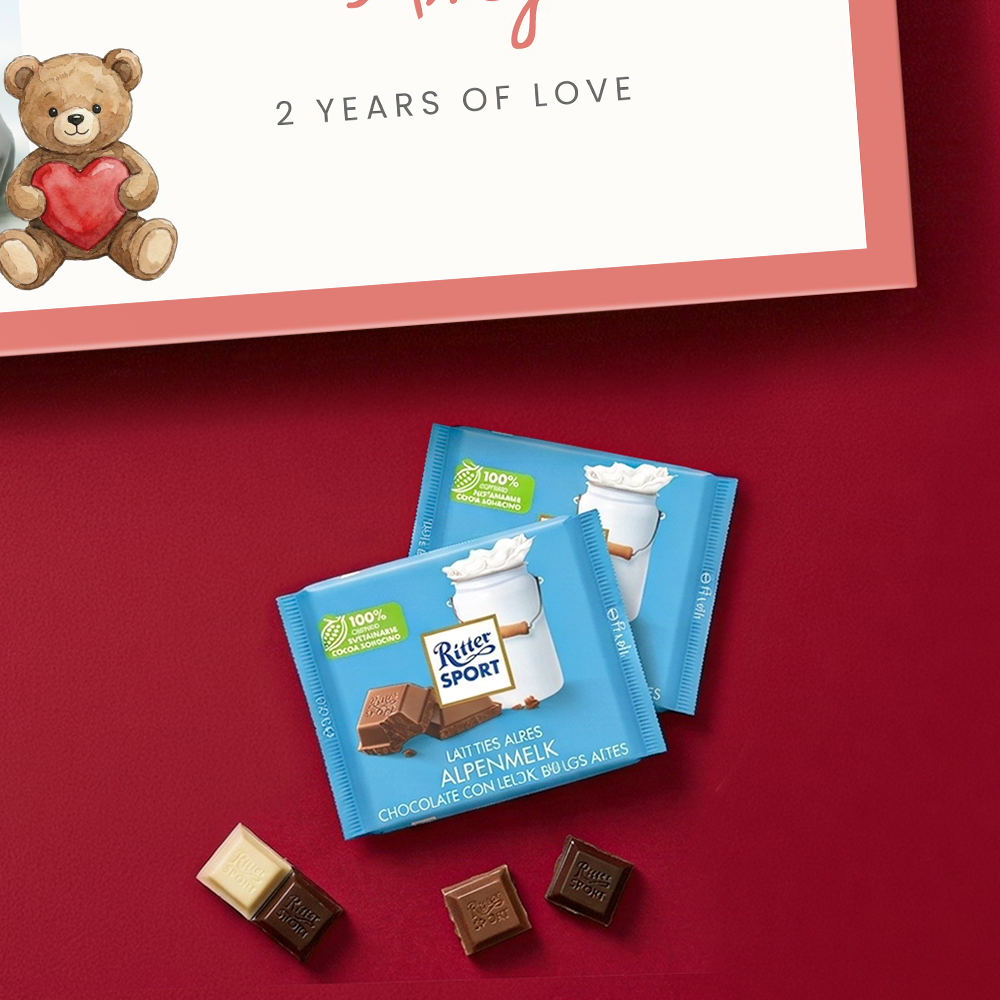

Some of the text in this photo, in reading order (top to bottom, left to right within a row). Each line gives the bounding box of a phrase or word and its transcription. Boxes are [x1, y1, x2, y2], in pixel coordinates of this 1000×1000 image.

[275, 75, 632, 126] 2 YEARS OF LOVE
[483, 471, 519, 488] 100%
[348, 608, 387, 627] 100%
[433, 631, 496, 671] Ritter
[440, 659, 500, 688] SPORT
[504, 725, 543, 747] ALRES
[441, 739, 559, 788] ALPENMELK
[378, 789, 460, 822] CHOCOLATE
[462, 779, 495, 799] CON
